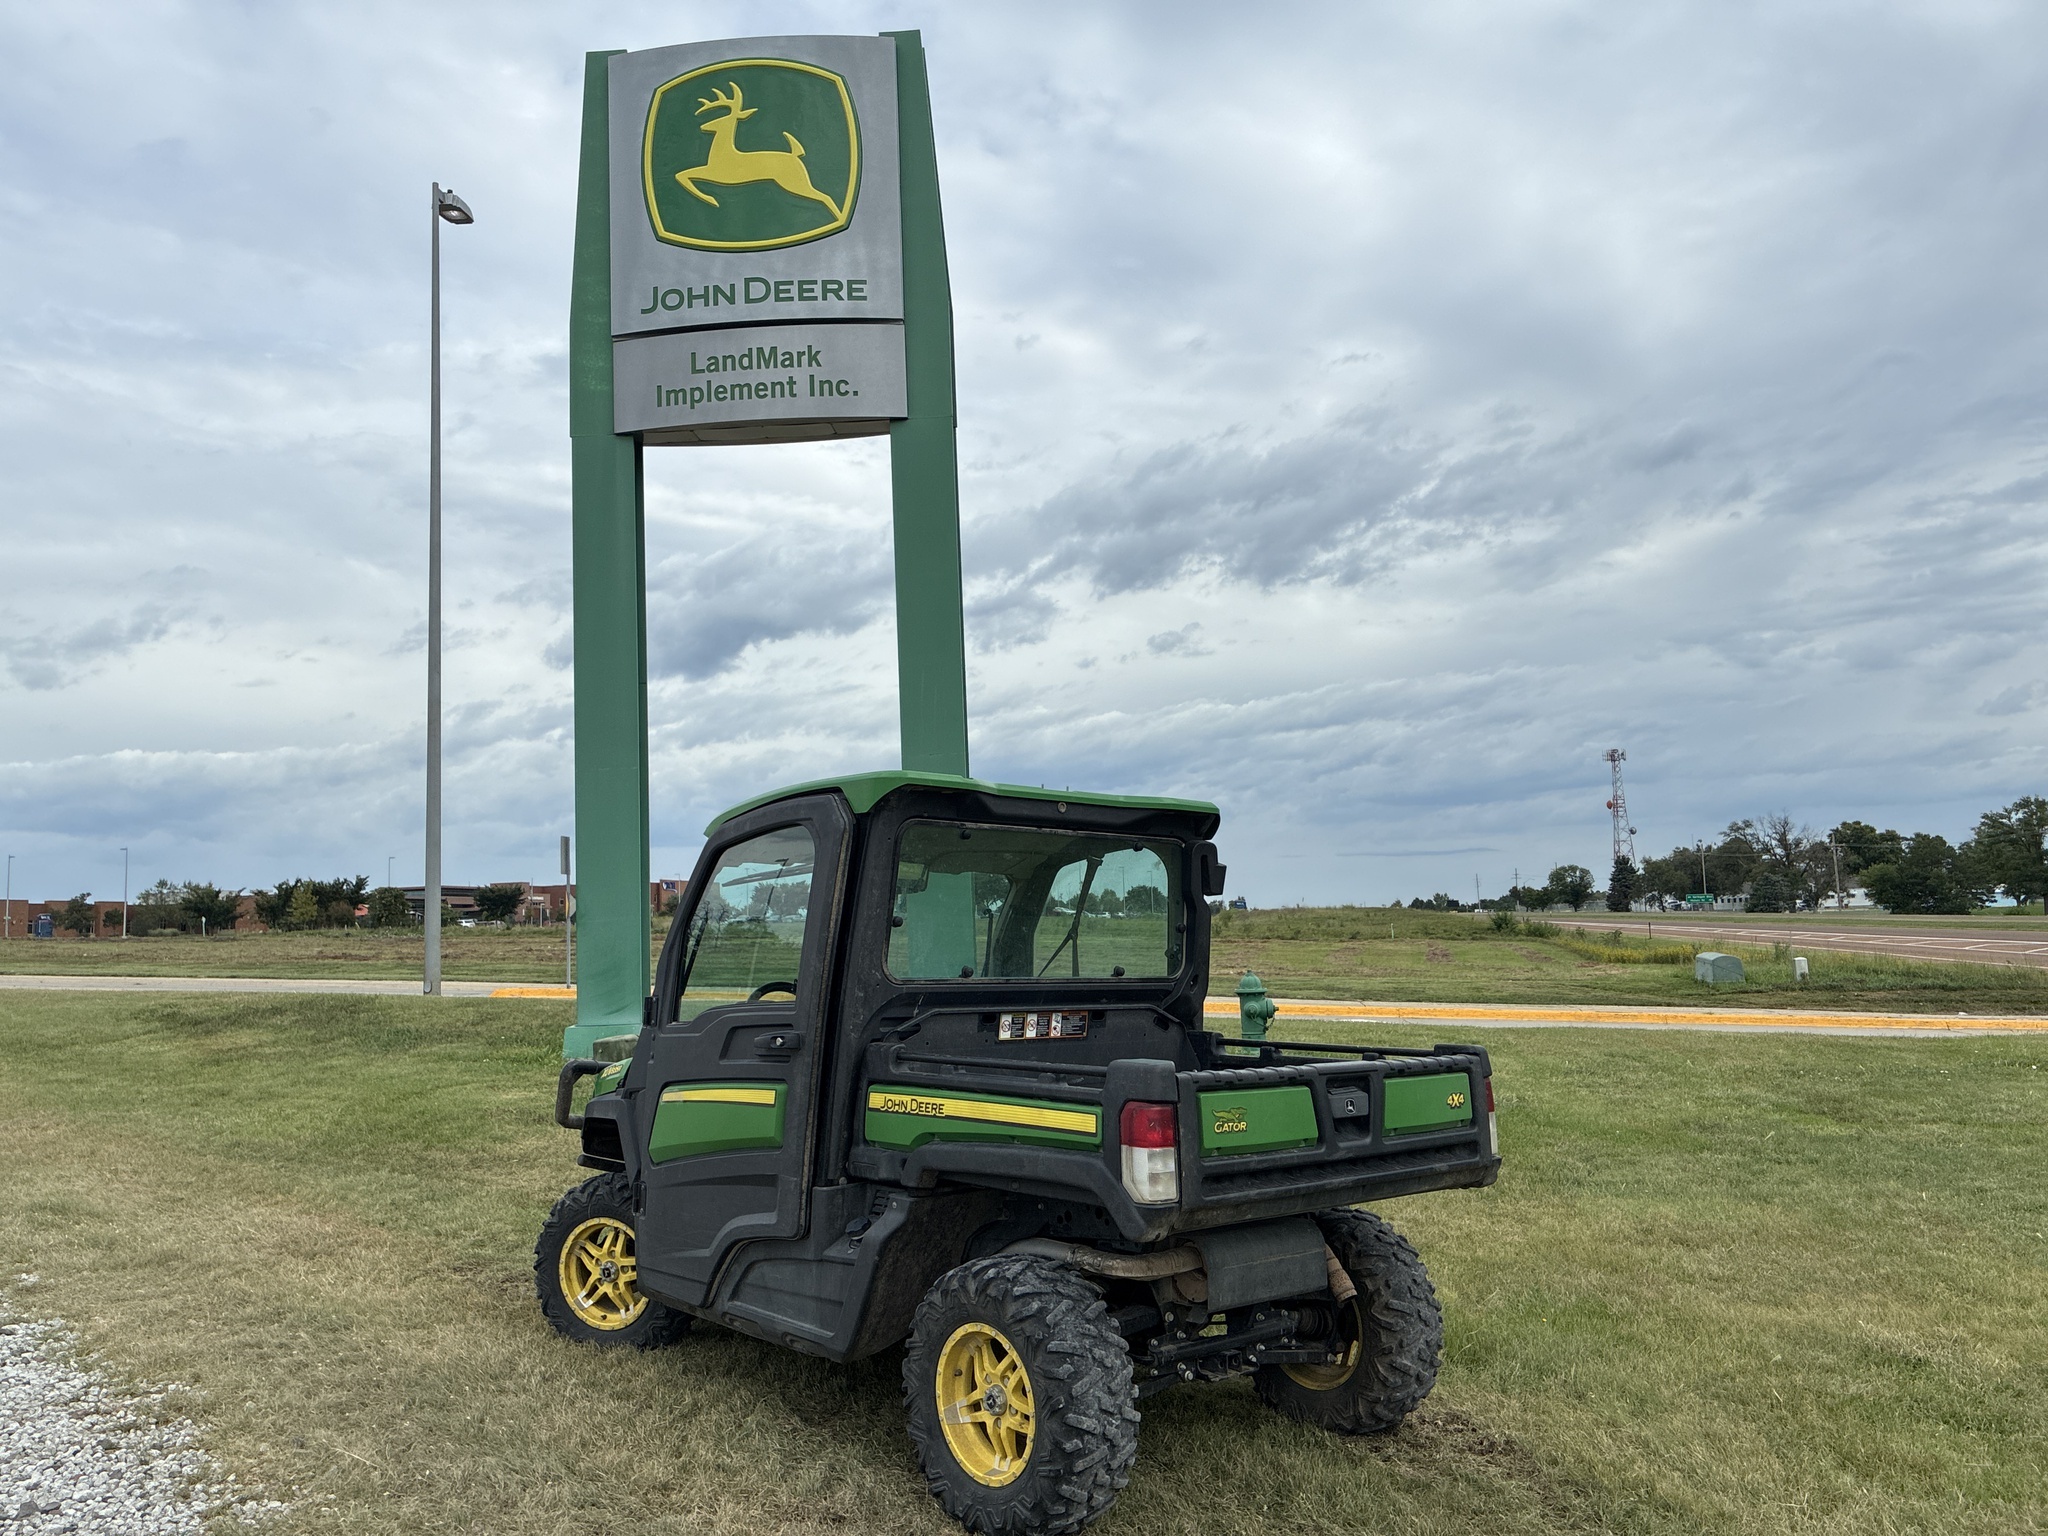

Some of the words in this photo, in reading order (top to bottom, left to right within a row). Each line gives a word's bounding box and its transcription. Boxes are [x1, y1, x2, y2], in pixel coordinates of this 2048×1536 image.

[640, 283, 736, 314] JOHN
[743, 276, 868, 304] DEERE
[690, 345, 822, 374] LandMark
[656, 376, 797, 409] Implement
[808, 374, 859, 397] Inc.
[880, 1096, 908, 1111] JOHN
[910, 1098, 945, 1115] DEERE
[1214, 1121, 1247, 1133] GATOR
